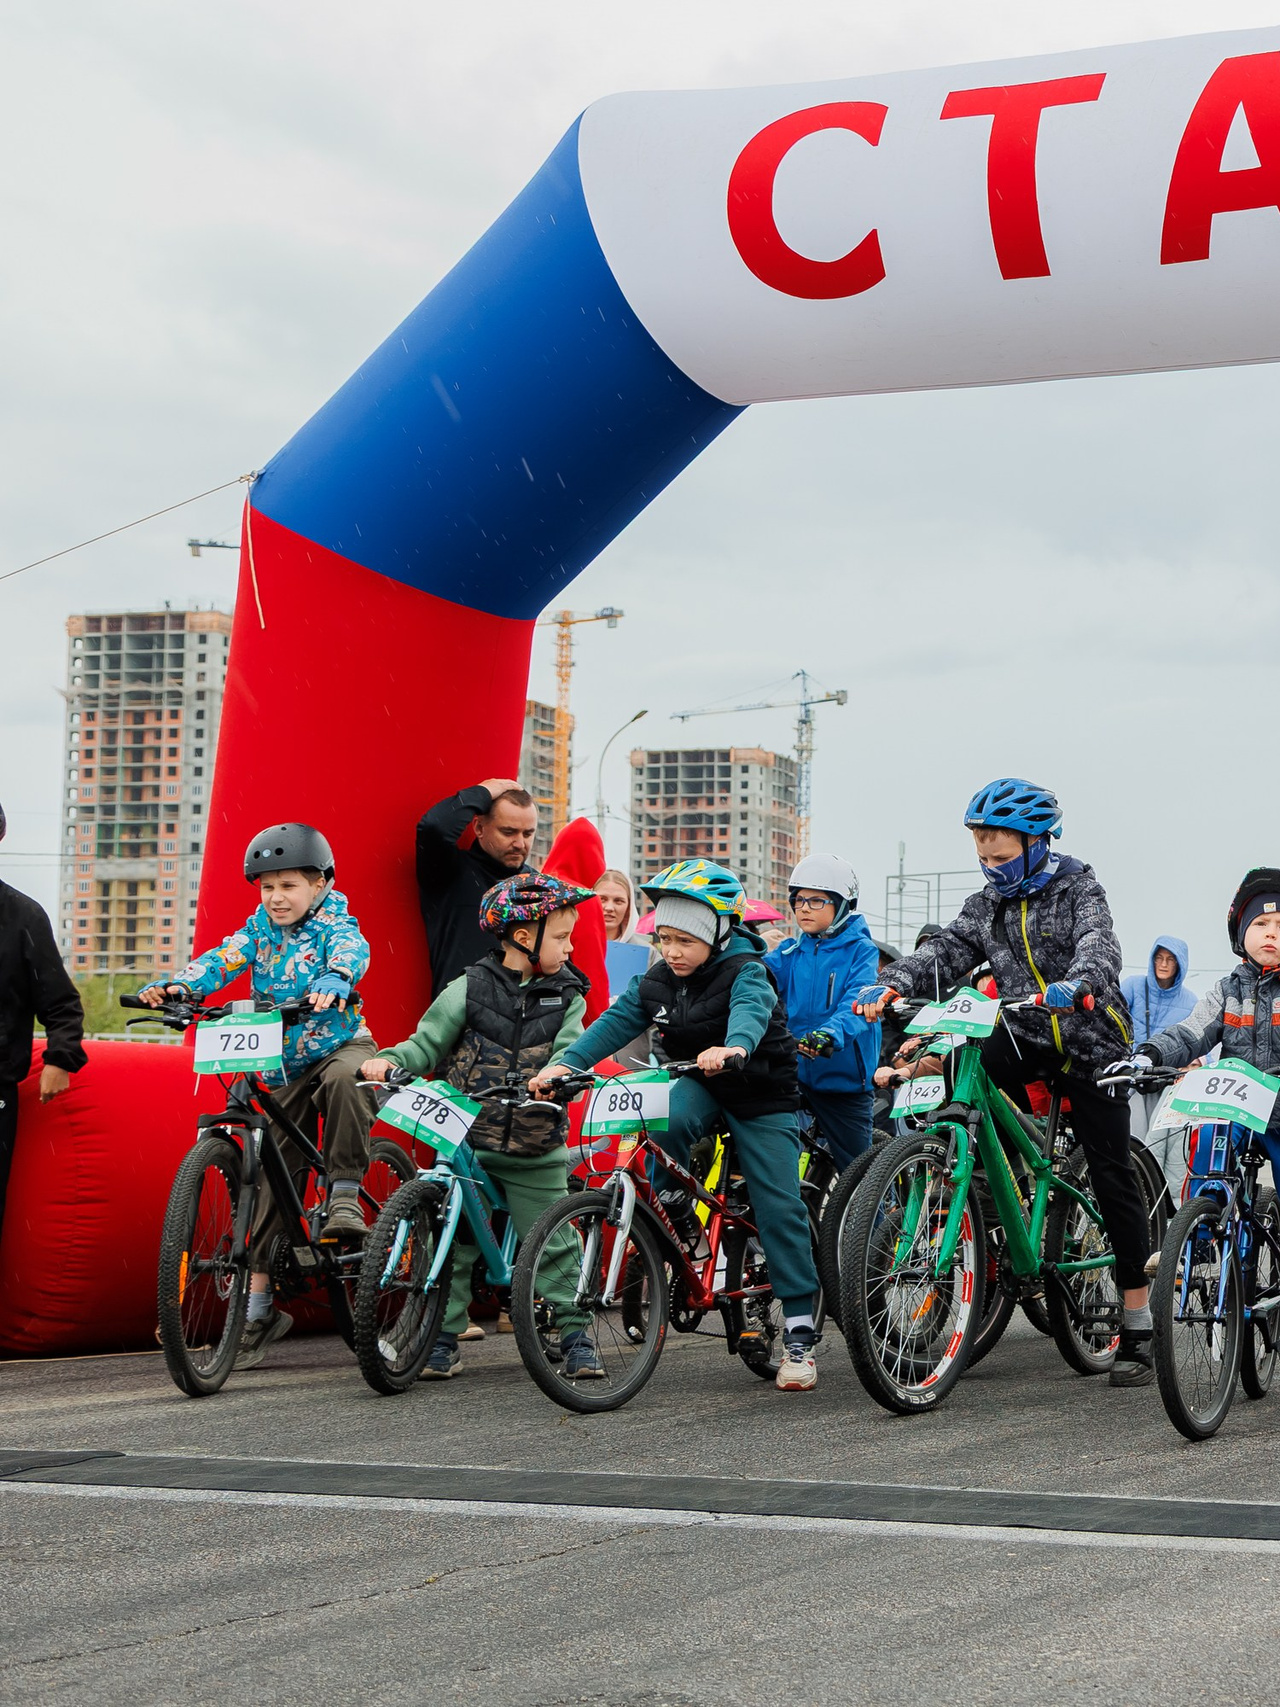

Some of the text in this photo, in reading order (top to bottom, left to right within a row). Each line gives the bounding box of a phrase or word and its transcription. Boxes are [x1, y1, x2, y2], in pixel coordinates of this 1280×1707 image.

[220, 1033, 259, 1051] 720
[913, 1085, 941, 1100] 949
[1205, 1077, 1247, 1101] 874
[411, 1094, 449, 1125] 878
[608, 1092, 643, 1112] 880
[922, 1143, 948, 1156] STE
[896, 1389, 937, 1405] STELS
